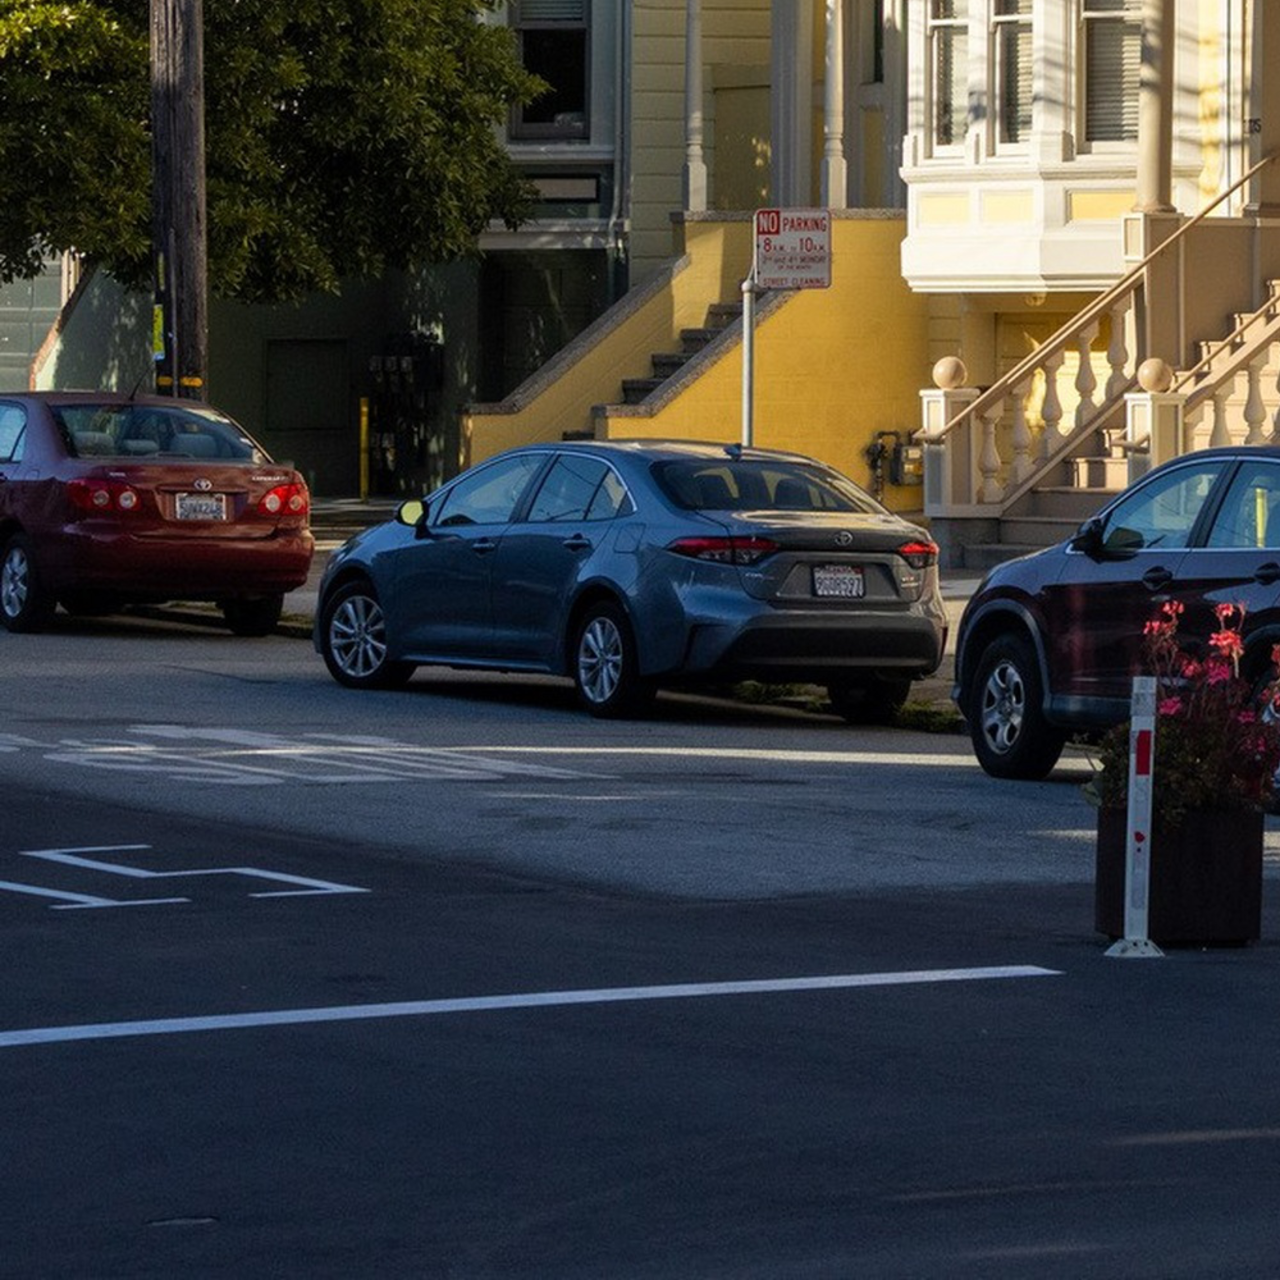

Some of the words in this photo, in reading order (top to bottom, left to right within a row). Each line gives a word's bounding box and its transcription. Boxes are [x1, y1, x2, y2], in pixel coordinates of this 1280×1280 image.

[760, 212, 778, 233] NO
[782, 217, 828, 233] PARKING
[763, 277, 788, 287] STREET
[792, 277, 826, 286] CLEANING
